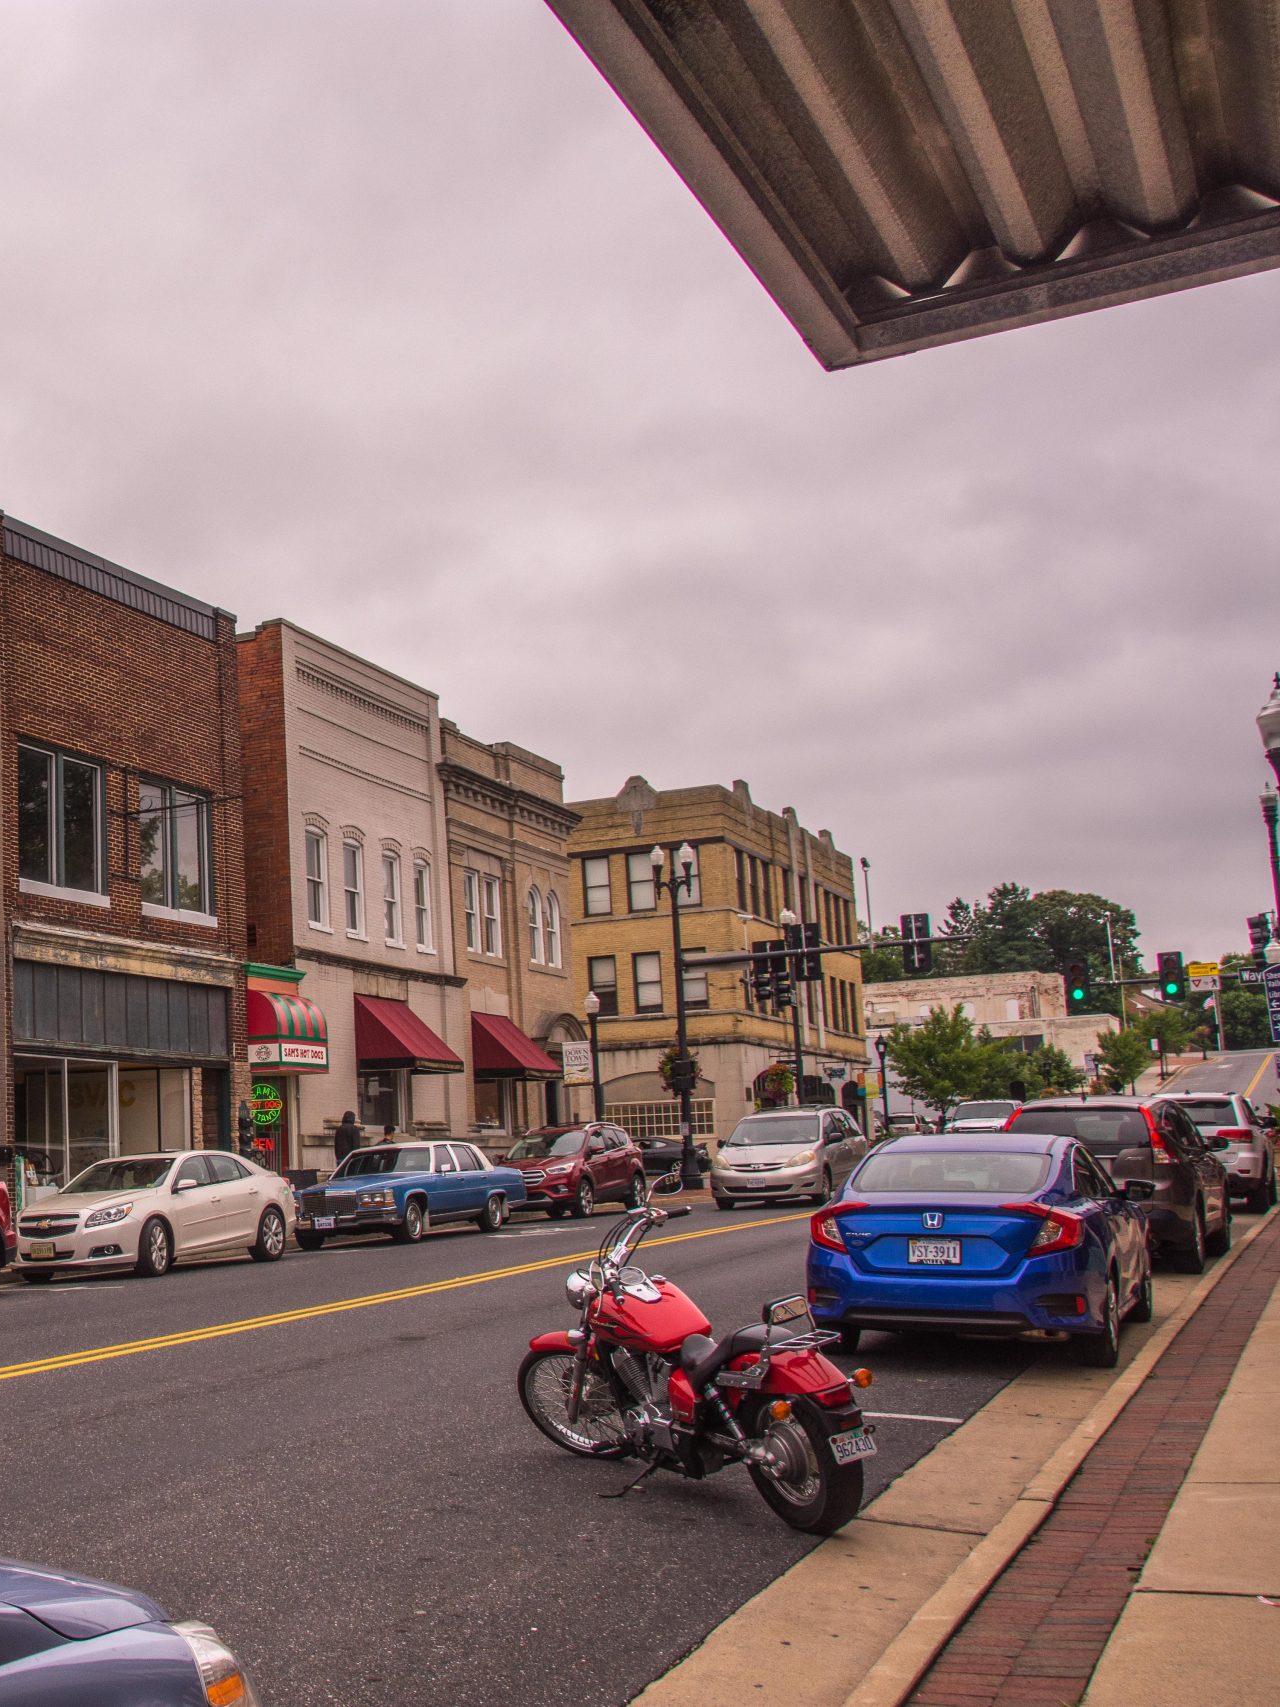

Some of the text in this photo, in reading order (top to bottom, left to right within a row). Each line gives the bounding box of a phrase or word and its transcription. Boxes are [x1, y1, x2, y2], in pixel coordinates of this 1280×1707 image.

[284, 1047, 324, 1060] SAM'S HOT DOGS
[565, 1048, 589, 1056] DOWN
[566, 1055, 589, 1063] TOWN
[265, 1100, 281, 1110] DOG
[253, 1138, 275, 1151] PEN
[911, 1245, 958, 1259] VSY-3911
